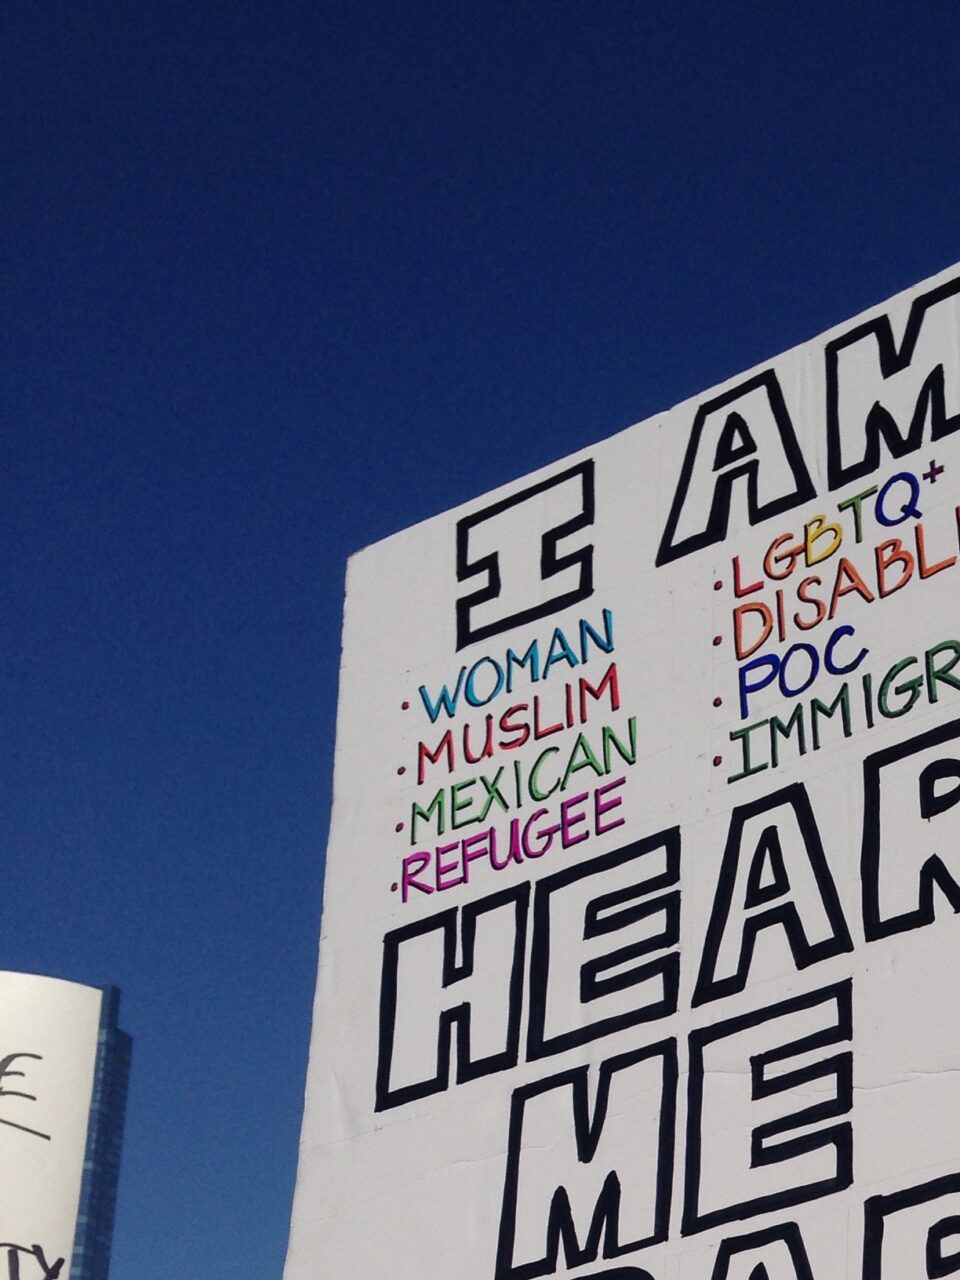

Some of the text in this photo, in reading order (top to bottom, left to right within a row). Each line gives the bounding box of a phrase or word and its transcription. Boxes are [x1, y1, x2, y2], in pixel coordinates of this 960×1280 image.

[455, 458, 594, 652] I
[416, 663, 620, 784] MUSLIM
[418, 609, 614, 724] WOMAN
[739, 625, 869, 718] POC
[401, 778, 628, 904] REFUGEE
[410, 716, 638, 845] MEXICAN
